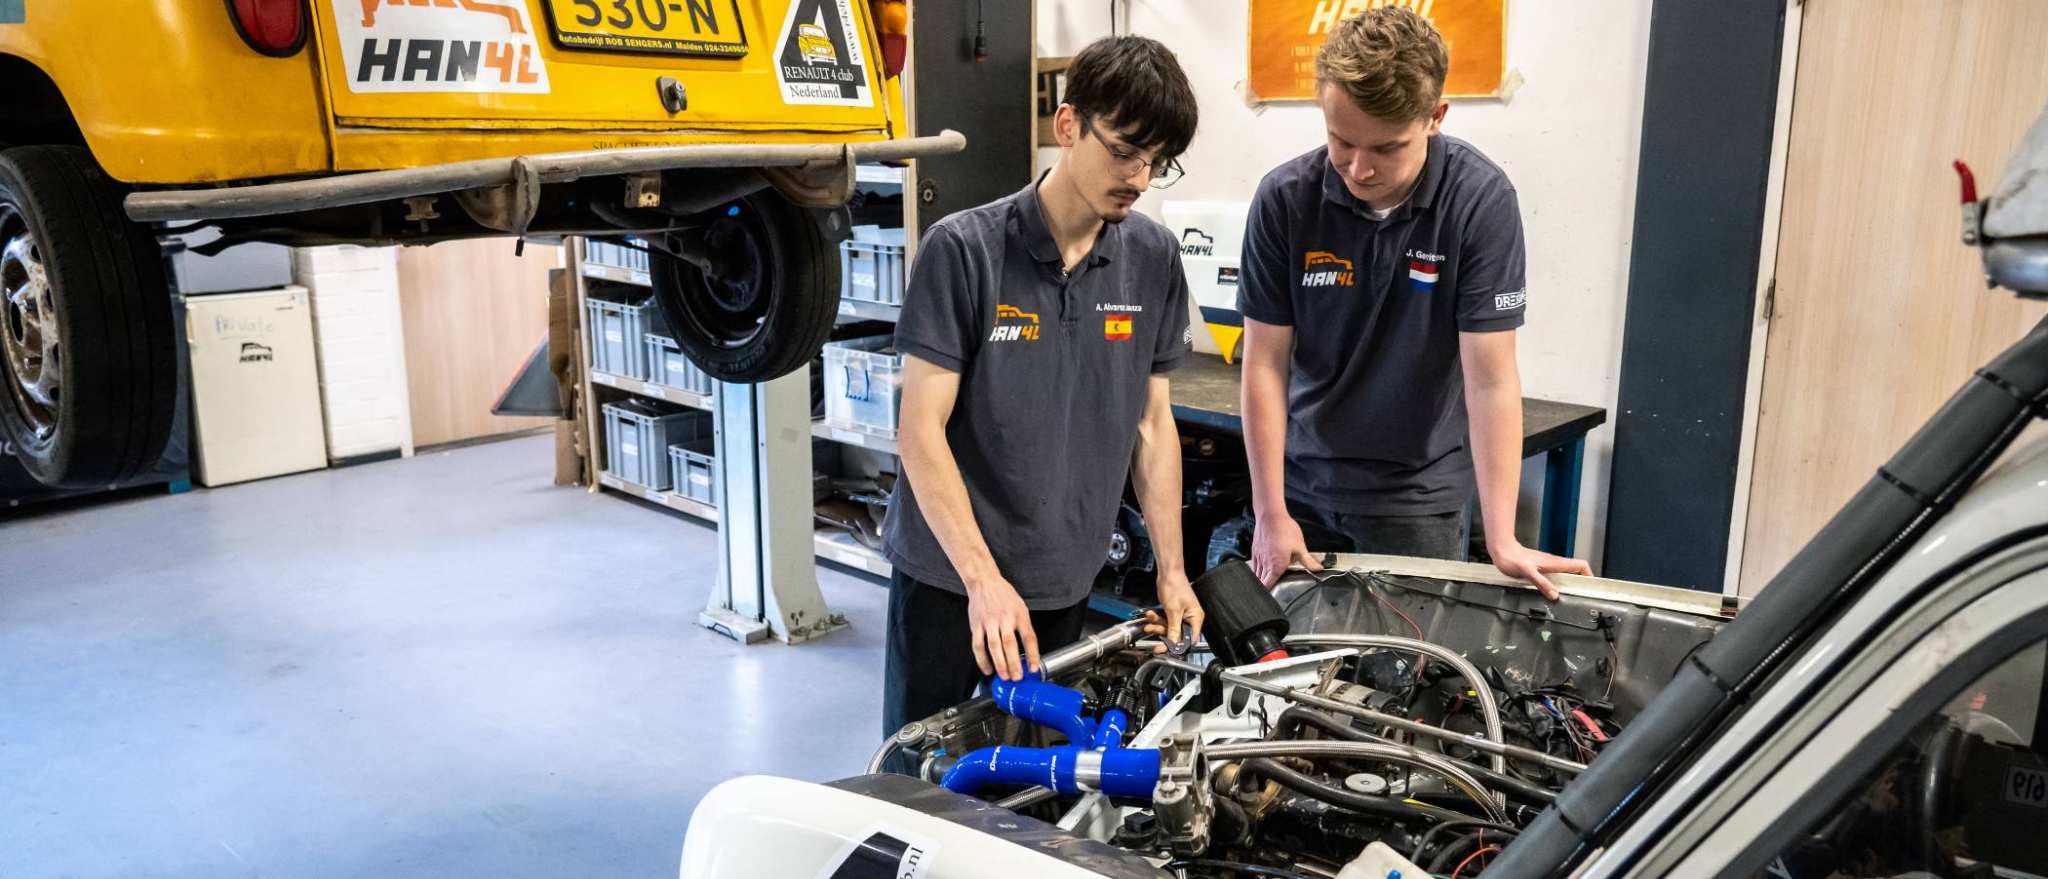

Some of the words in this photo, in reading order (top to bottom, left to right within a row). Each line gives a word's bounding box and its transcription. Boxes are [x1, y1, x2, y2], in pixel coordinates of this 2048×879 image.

[605, 38, 623, 46] ROB
[357, 38, 538, 84] HAN4L
[784, 66, 830, 80] RENAULT
[831, 69, 837, 80] 4
[838, 68, 854, 81] club
[790, 84, 840, 98] Nederland
[1406, 248, 1414, 257] J.
[1301, 271, 1354, 287] HAN4L
[1095, 302, 1103, 312] A.
